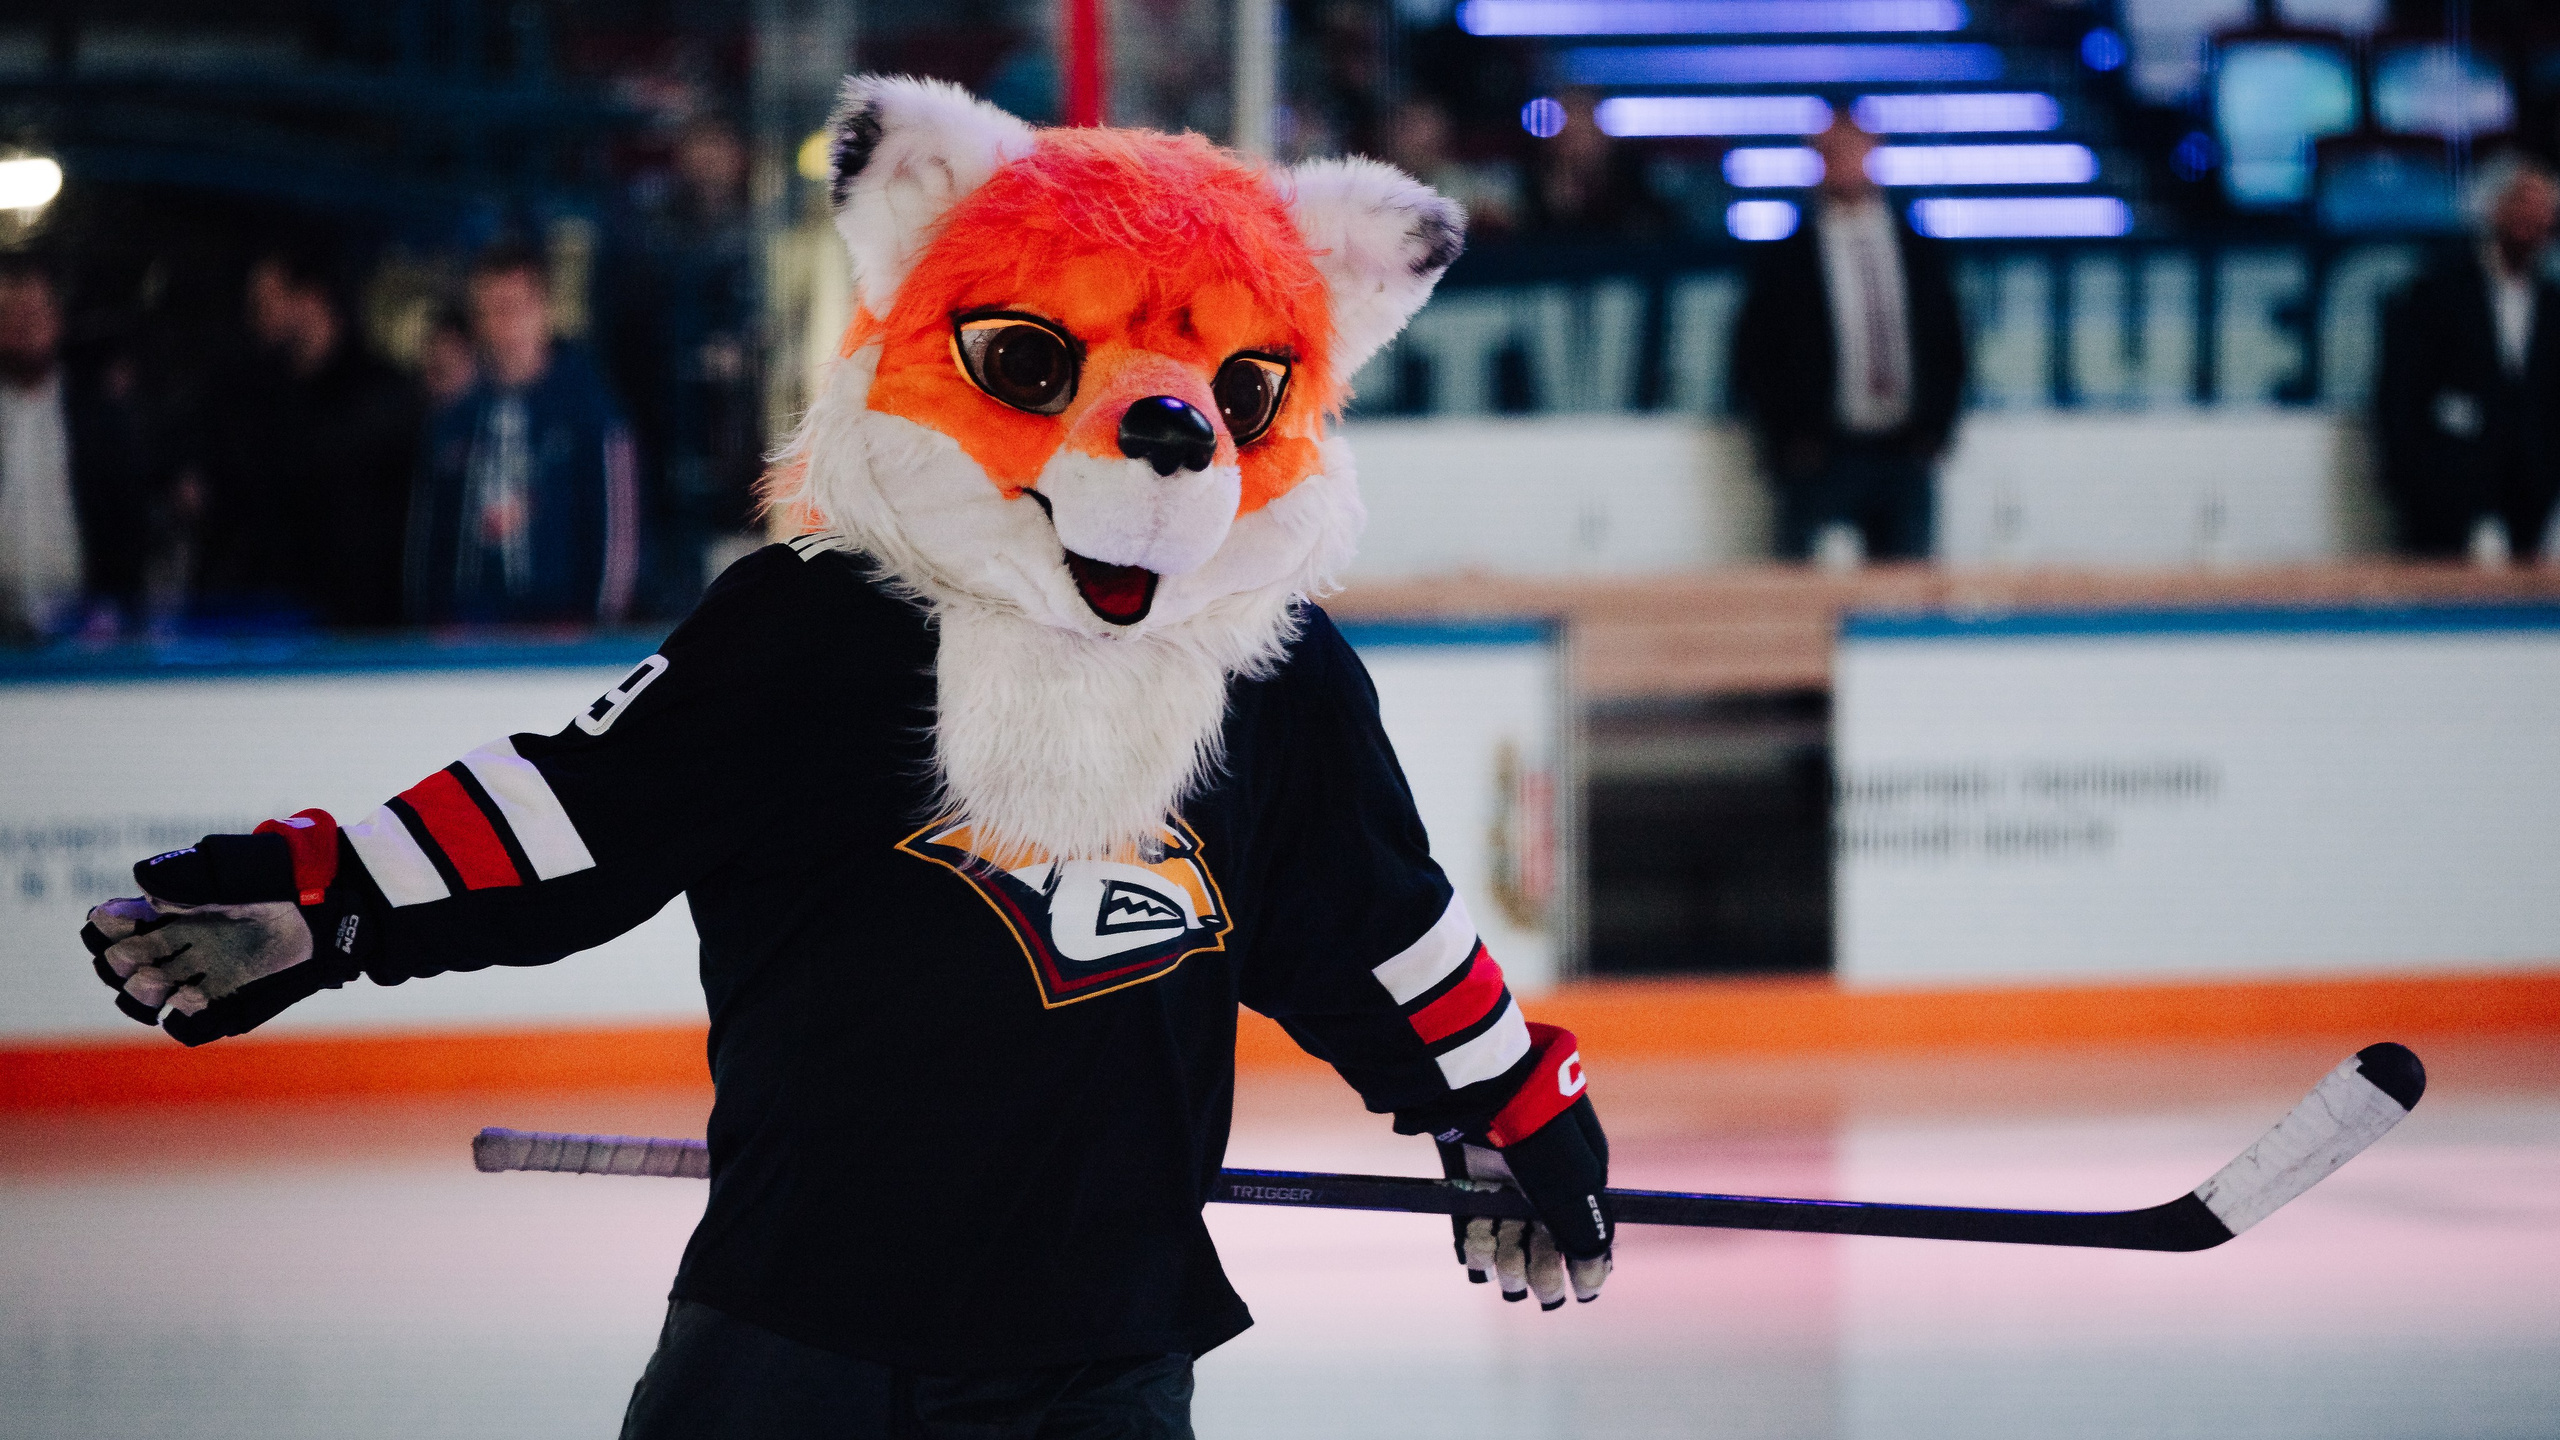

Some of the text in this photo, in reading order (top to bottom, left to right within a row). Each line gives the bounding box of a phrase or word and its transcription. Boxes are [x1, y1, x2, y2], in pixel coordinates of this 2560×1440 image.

[575, 653, 669, 736] 9
[150, 847, 196, 866] CCM
[341, 914, 360, 954] CCM
[1230, 1184, 1314, 1202] TRIGGER
[1586, 1194, 1606, 1240] CCM
